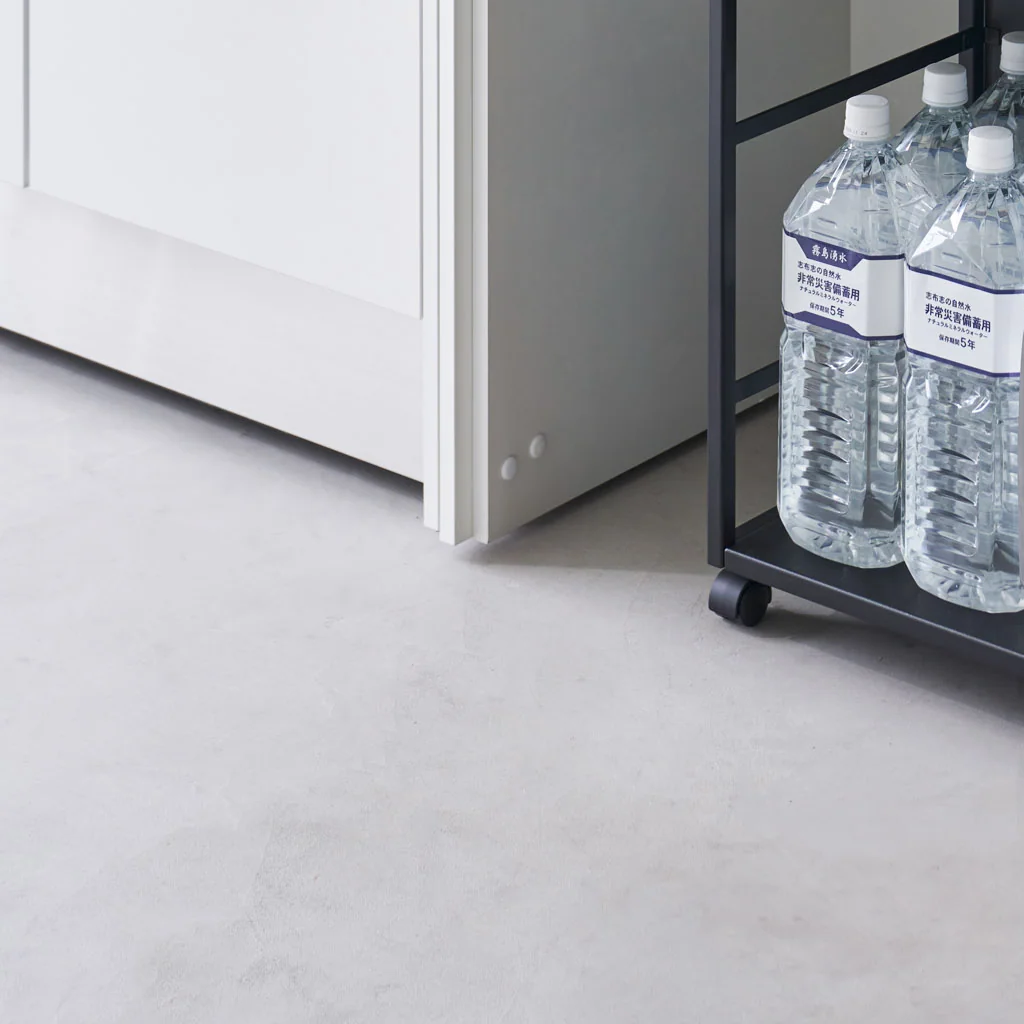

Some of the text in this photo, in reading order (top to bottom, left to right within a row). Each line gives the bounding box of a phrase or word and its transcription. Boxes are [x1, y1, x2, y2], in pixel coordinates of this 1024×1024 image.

[797, 260, 842, 281] 志布志の自然水
[797, 272, 860, 302] 非常災害備蓄用
[925, 291, 972, 312] 志布志の自然水
[925, 303, 991, 333] 非常災害備蓄用
